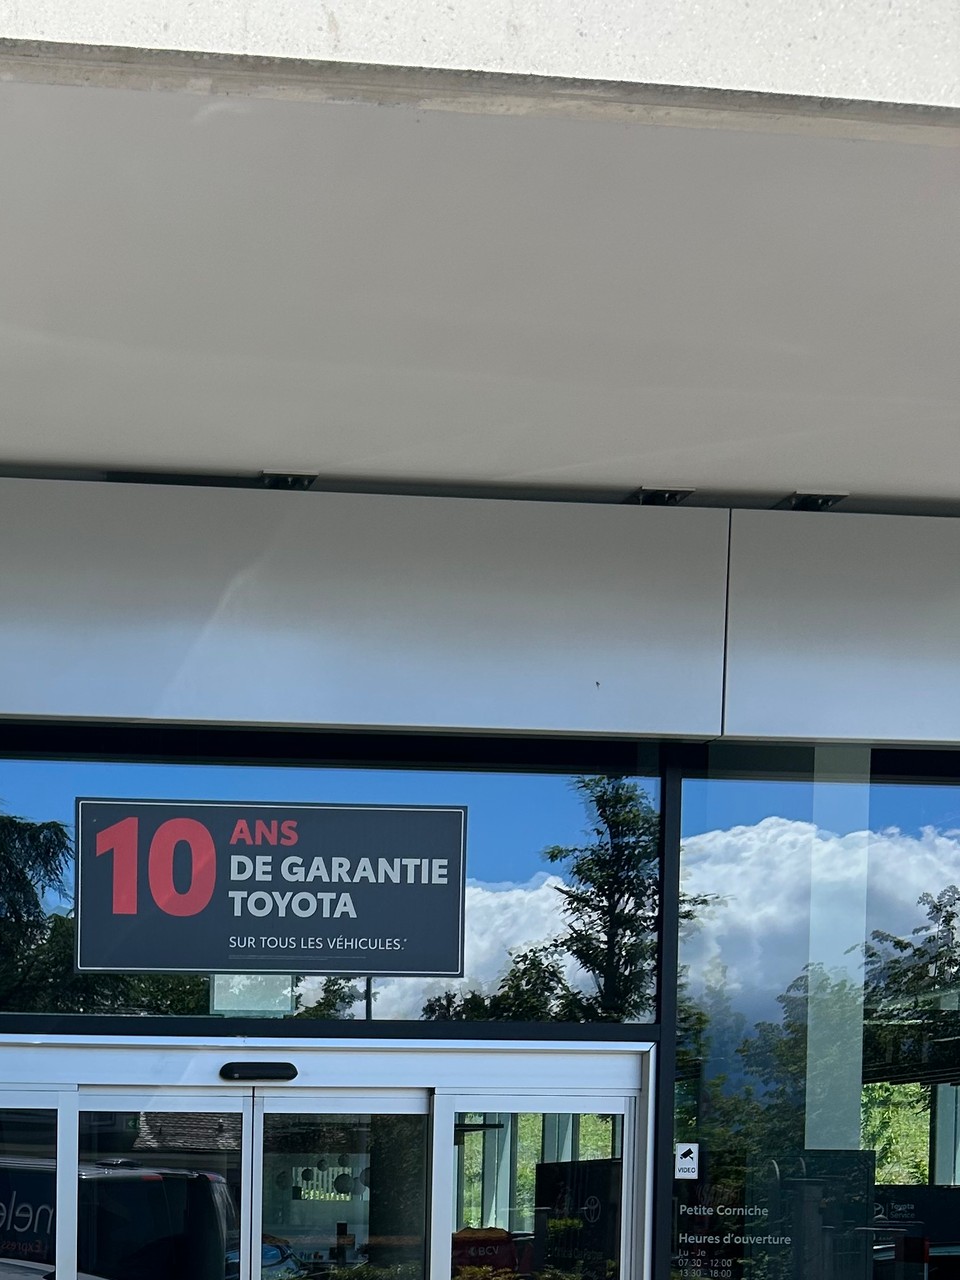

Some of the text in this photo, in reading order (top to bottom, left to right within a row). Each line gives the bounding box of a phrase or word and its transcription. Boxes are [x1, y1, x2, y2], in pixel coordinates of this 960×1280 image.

[229, 819, 299, 847] ANS
[95, 816, 217, 917] 10
[230, 855, 449, 885] DE GARANTIE
[228, 890, 358, 919] TOYOTA
[229, 936, 256, 950] SUR
[260, 936, 298, 950] TOUS
[301, 937, 324, 950] LES
[679, 1204, 769, 1216] Petite Corniche
[678, 1233, 721, 1244] Heures
[478, 1245, 499, 1256] BCV
[696, 1248, 707, 1257] Je
[710, 1258, 732, 1267] 12:00
[709, 1269, 732, 1278] 18:00
